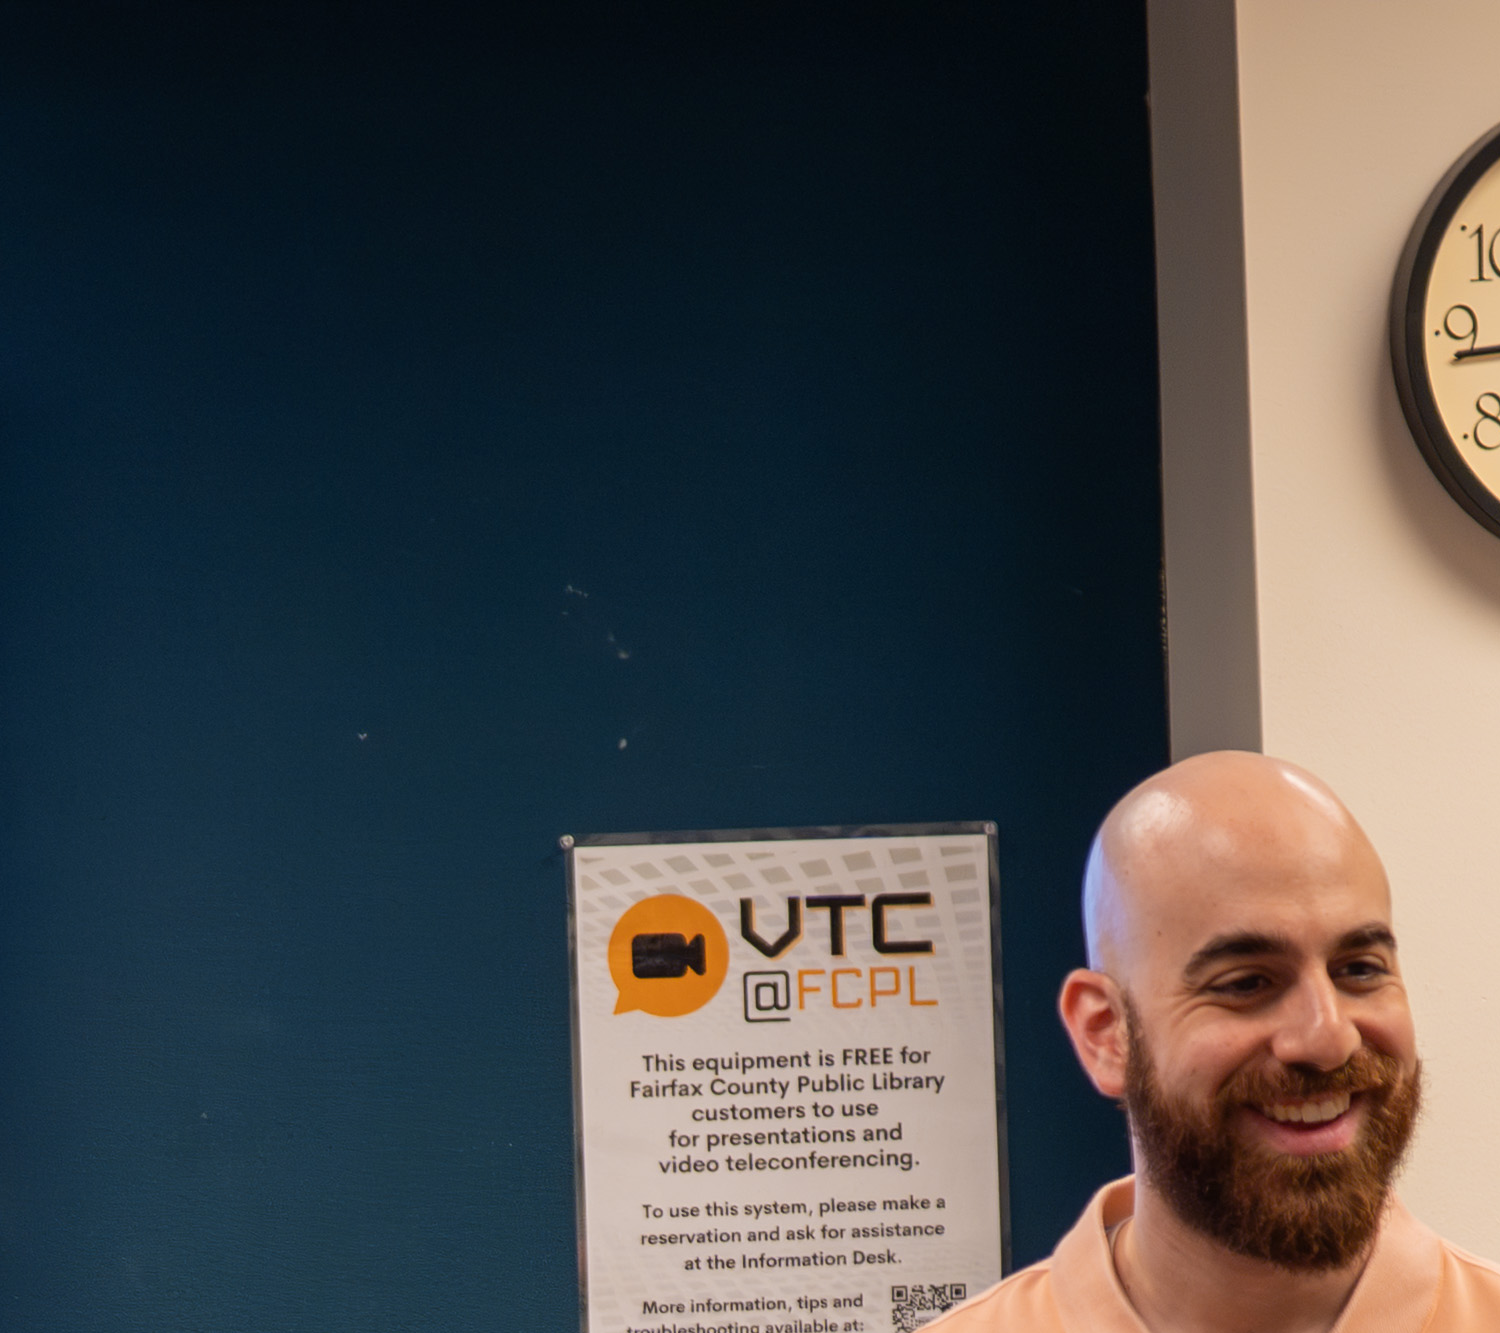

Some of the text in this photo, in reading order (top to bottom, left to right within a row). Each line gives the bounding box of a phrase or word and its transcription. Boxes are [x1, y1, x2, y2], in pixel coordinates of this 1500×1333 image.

[1443, 304, 1480, 351] 9
[739, 893, 936, 960] VTC
[743, 966, 939, 1023] @FCPL
[641, 1046, 931, 1075] This equipment is FREE for
[630, 1071, 945, 1098] Fairfax County Public Library
[691, 1102, 879, 1123] customers to use
[668, 1122, 903, 1151] for presentations and
[658, 1149, 920, 1174] video teleconferencing.
[642, 1194, 945, 1220] To use this system, please make a
[640, 1222, 945, 1246] reservation and ask for assistance
[684, 1248, 902, 1271] at the Information Desk.
[642, 1293, 863, 1315] More information, tips and
[842, 1319, 864, 1333] at:
